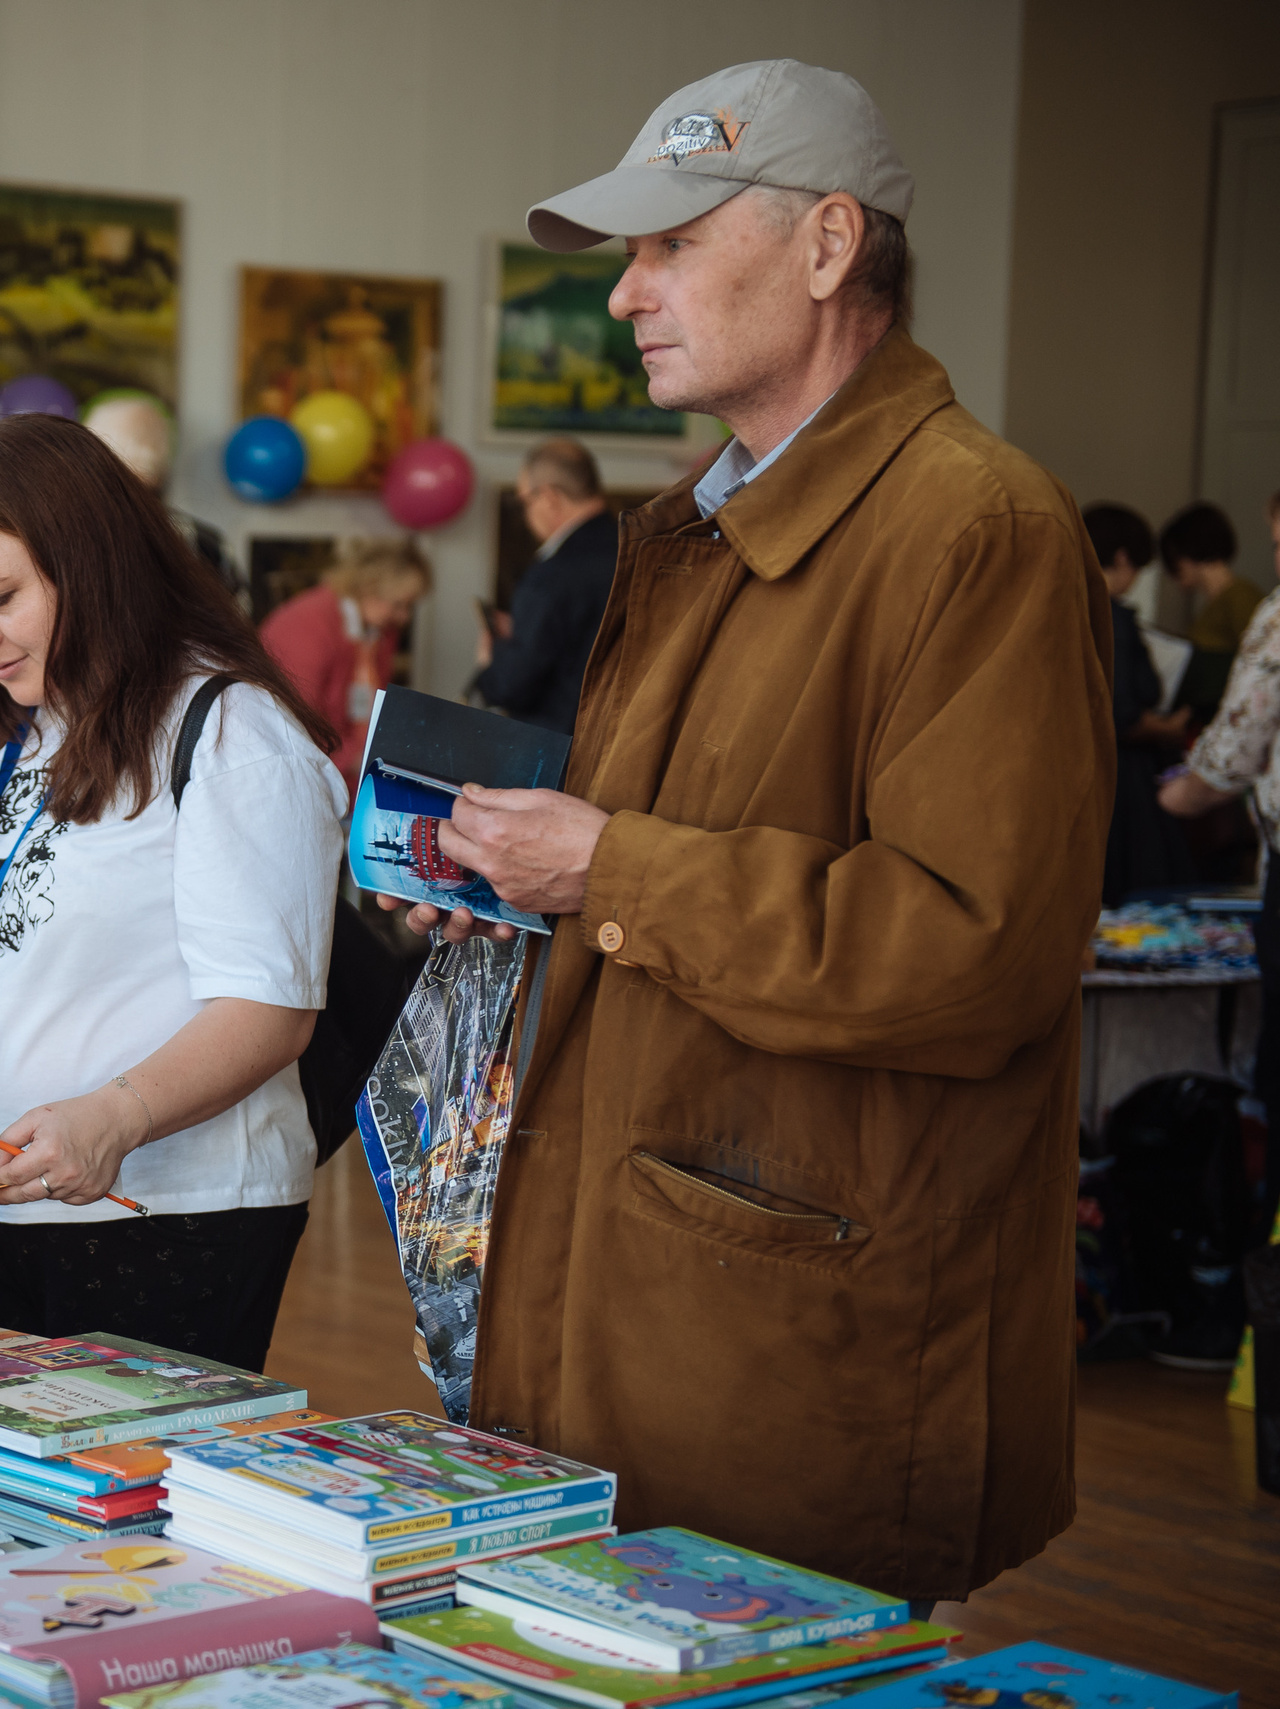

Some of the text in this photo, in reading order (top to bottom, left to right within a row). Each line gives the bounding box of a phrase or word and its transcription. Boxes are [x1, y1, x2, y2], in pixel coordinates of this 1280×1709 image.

[176, 1402, 256, 1429] РУКОДЕЛИЕ
[480, 1530, 517, 1551] ЛЮБЛЮ
[519, 1523, 553, 1542] СПОРТ
[770, 1627, 803, 1650] ПОРА
[101, 1637, 293, 1690] Наша малышка
